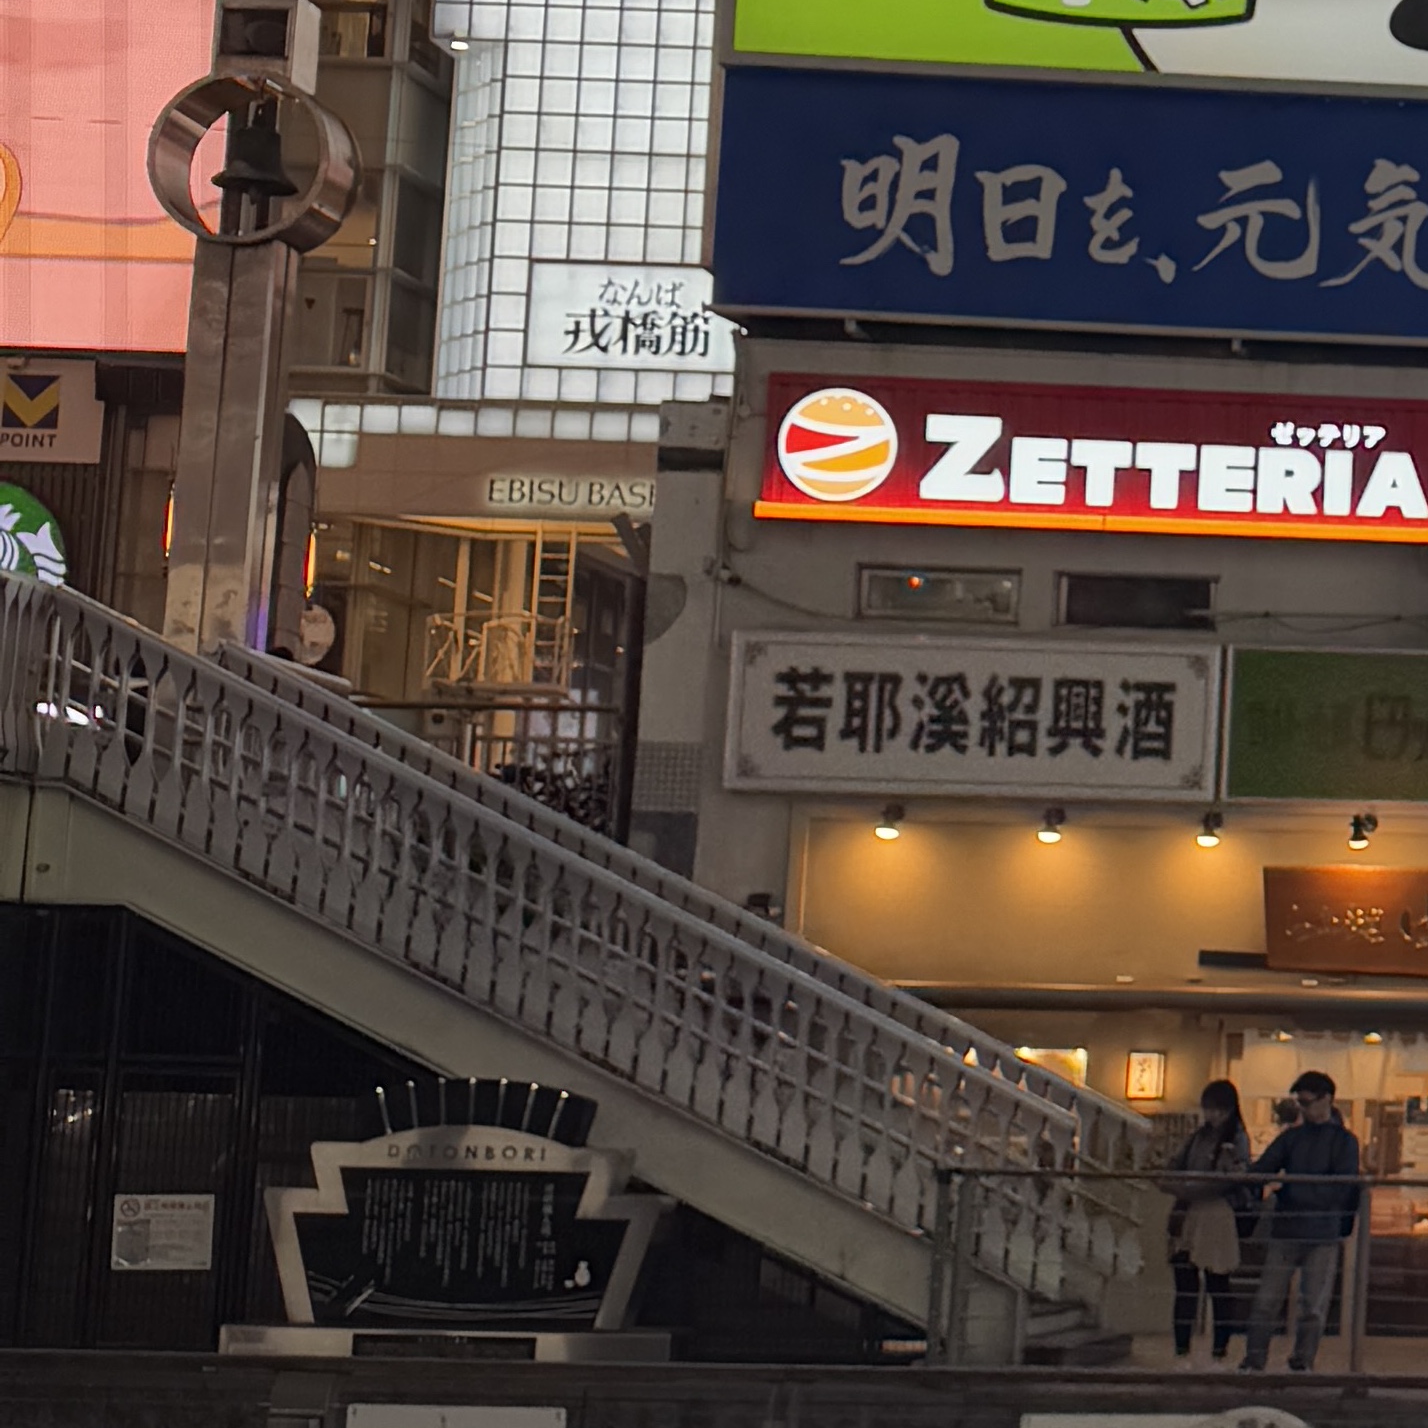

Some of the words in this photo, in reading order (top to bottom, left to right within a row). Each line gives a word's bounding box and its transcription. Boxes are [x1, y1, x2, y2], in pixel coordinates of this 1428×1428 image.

[599, 277, 684, 308] なんば
[563, 307, 711, 356] 戎橋筋
[0, 433, 57, 449] POINT
[1270, 421, 1387, 449] ゼッテリア
[488, 477, 579, 506] EBISU
